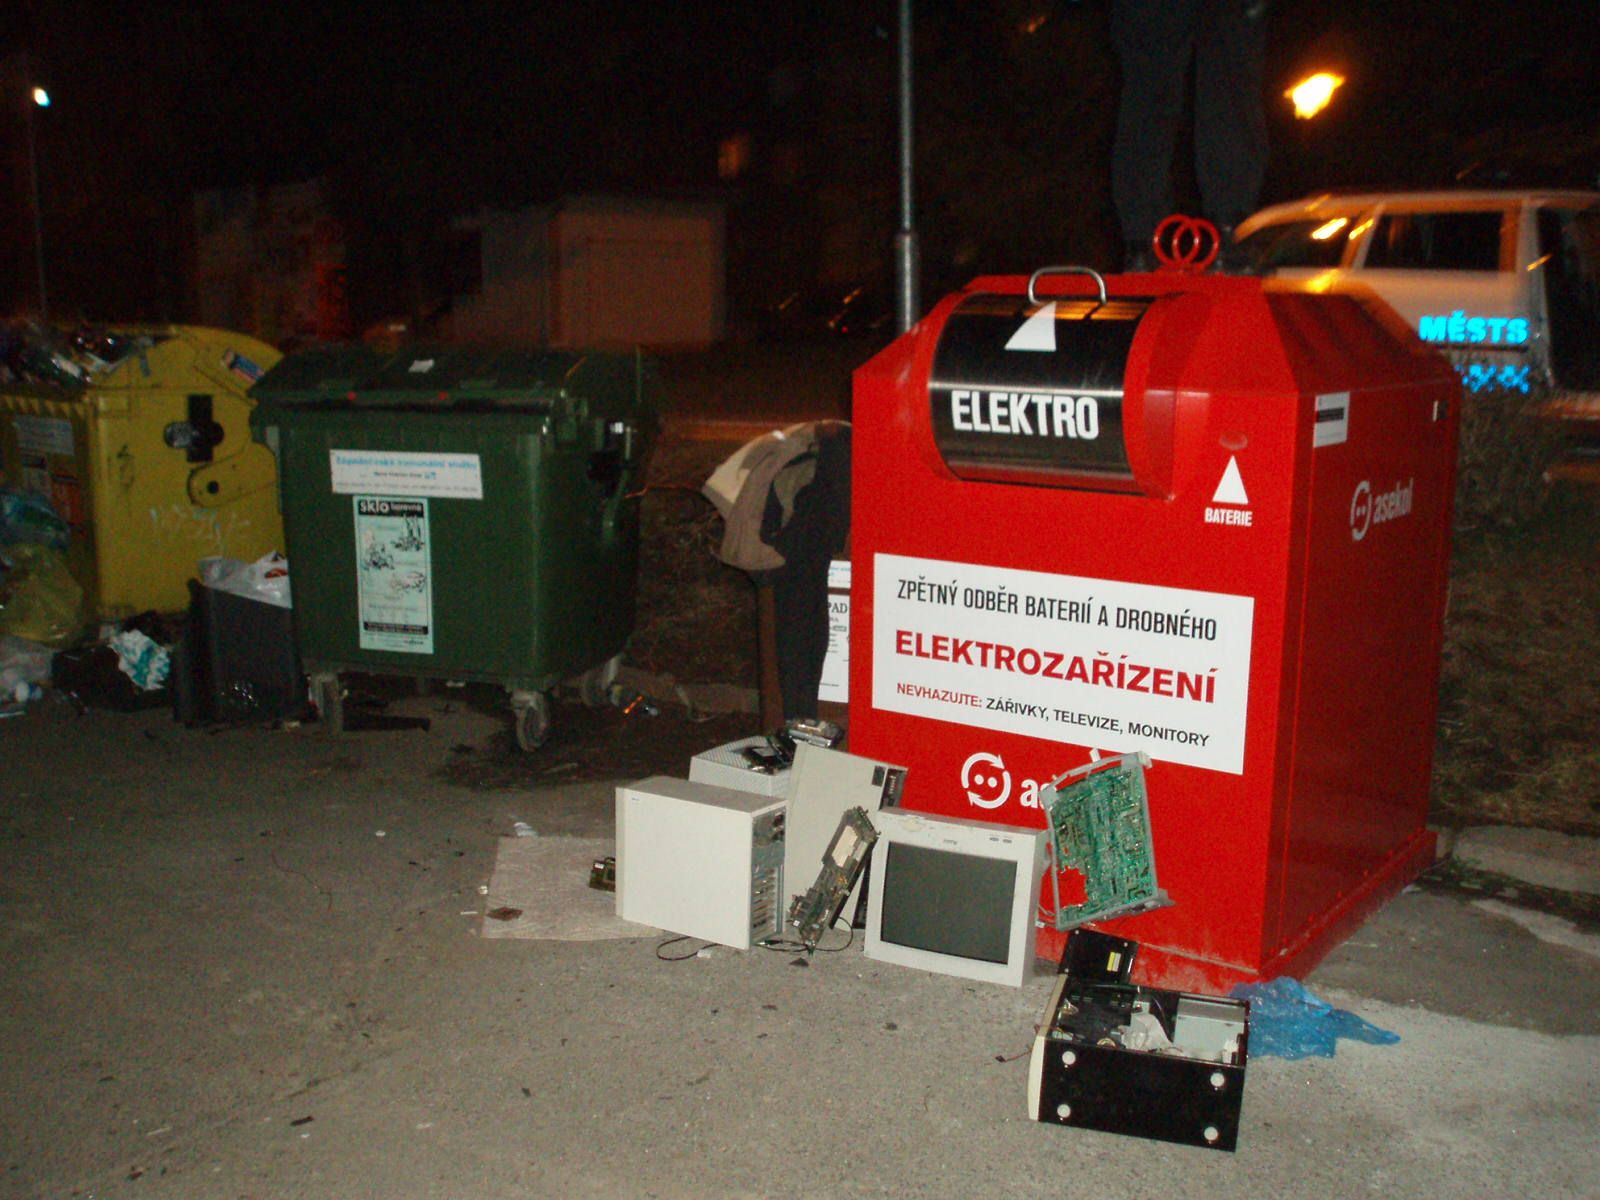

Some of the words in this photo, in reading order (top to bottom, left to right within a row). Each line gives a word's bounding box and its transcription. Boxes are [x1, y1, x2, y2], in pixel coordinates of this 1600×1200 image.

[951, 390, 1100, 440] ELEKTRO
[1204, 507, 1253, 527] BATERIE
[1373, 476, 1415, 525] asekol
[897, 575, 958, 606] ZPĚTNÝ
[963, 585, 1018, 615] ODBĚR
[1025, 595, 1094, 625] BATERIÍ
[1097, 605, 1109, 627] A
[1115, 608, 1217, 641] DROBNÉHO
[895, 628, 1219, 704] ELEKTROZAŘÍZENÍ
[896, 682, 983, 708] NEVHAZUJTE:
[985, 696, 1050, 722] ZÁŘIVKY,
[1052, 708, 1124, 735] TELEVIZE,
[1127, 721, 1211, 747] MONITORY
